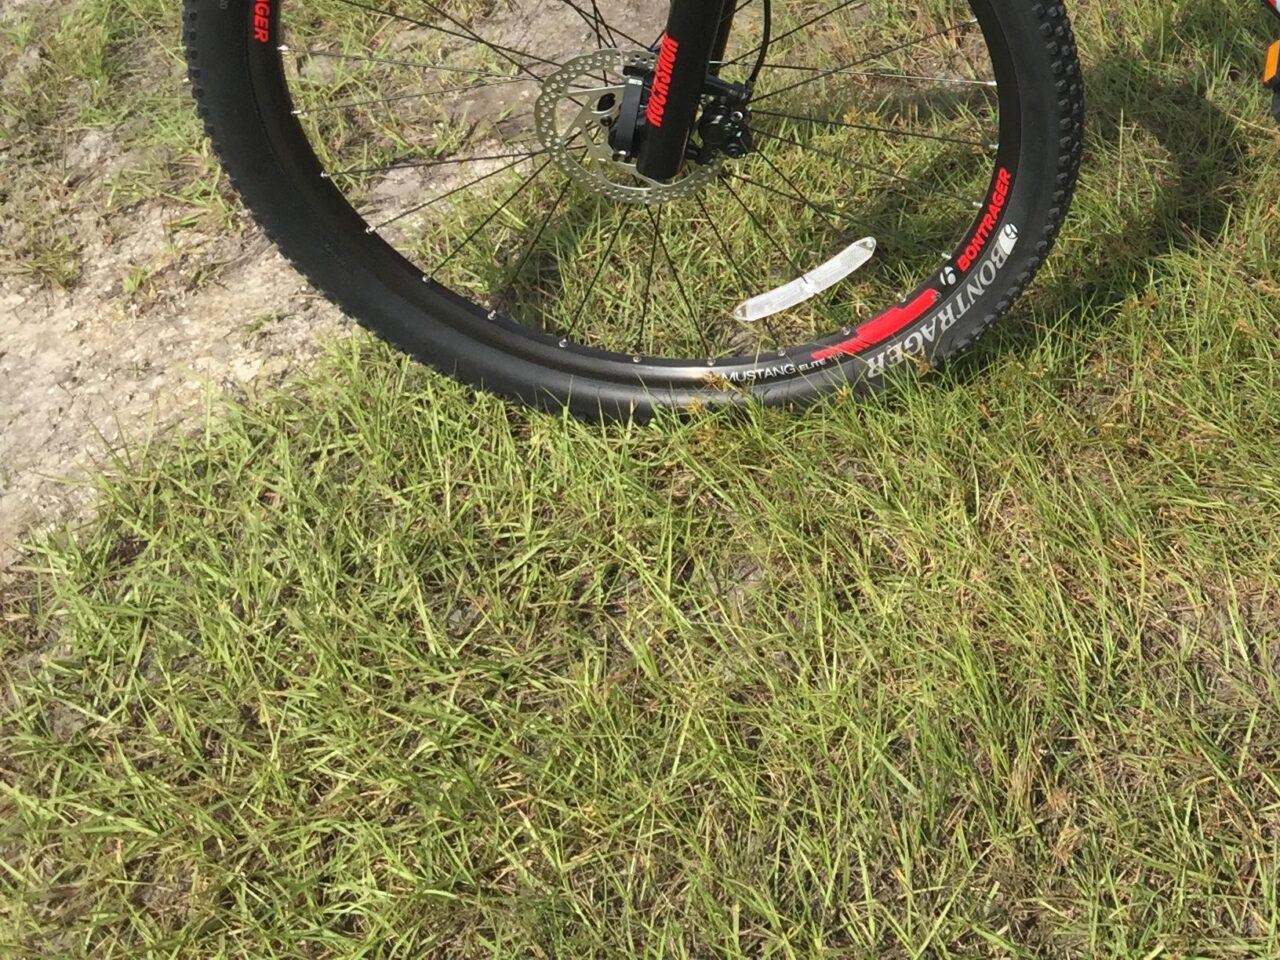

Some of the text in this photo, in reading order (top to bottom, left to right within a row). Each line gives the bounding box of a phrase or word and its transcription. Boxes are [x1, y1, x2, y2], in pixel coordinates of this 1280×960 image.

[957, 167, 1012, 272] BONTRAGER
[867, 240, 1010, 379] BONTRAGER
[722, 364, 796, 382] MUSTANG
[799, 358, 826, 371] ELITE
